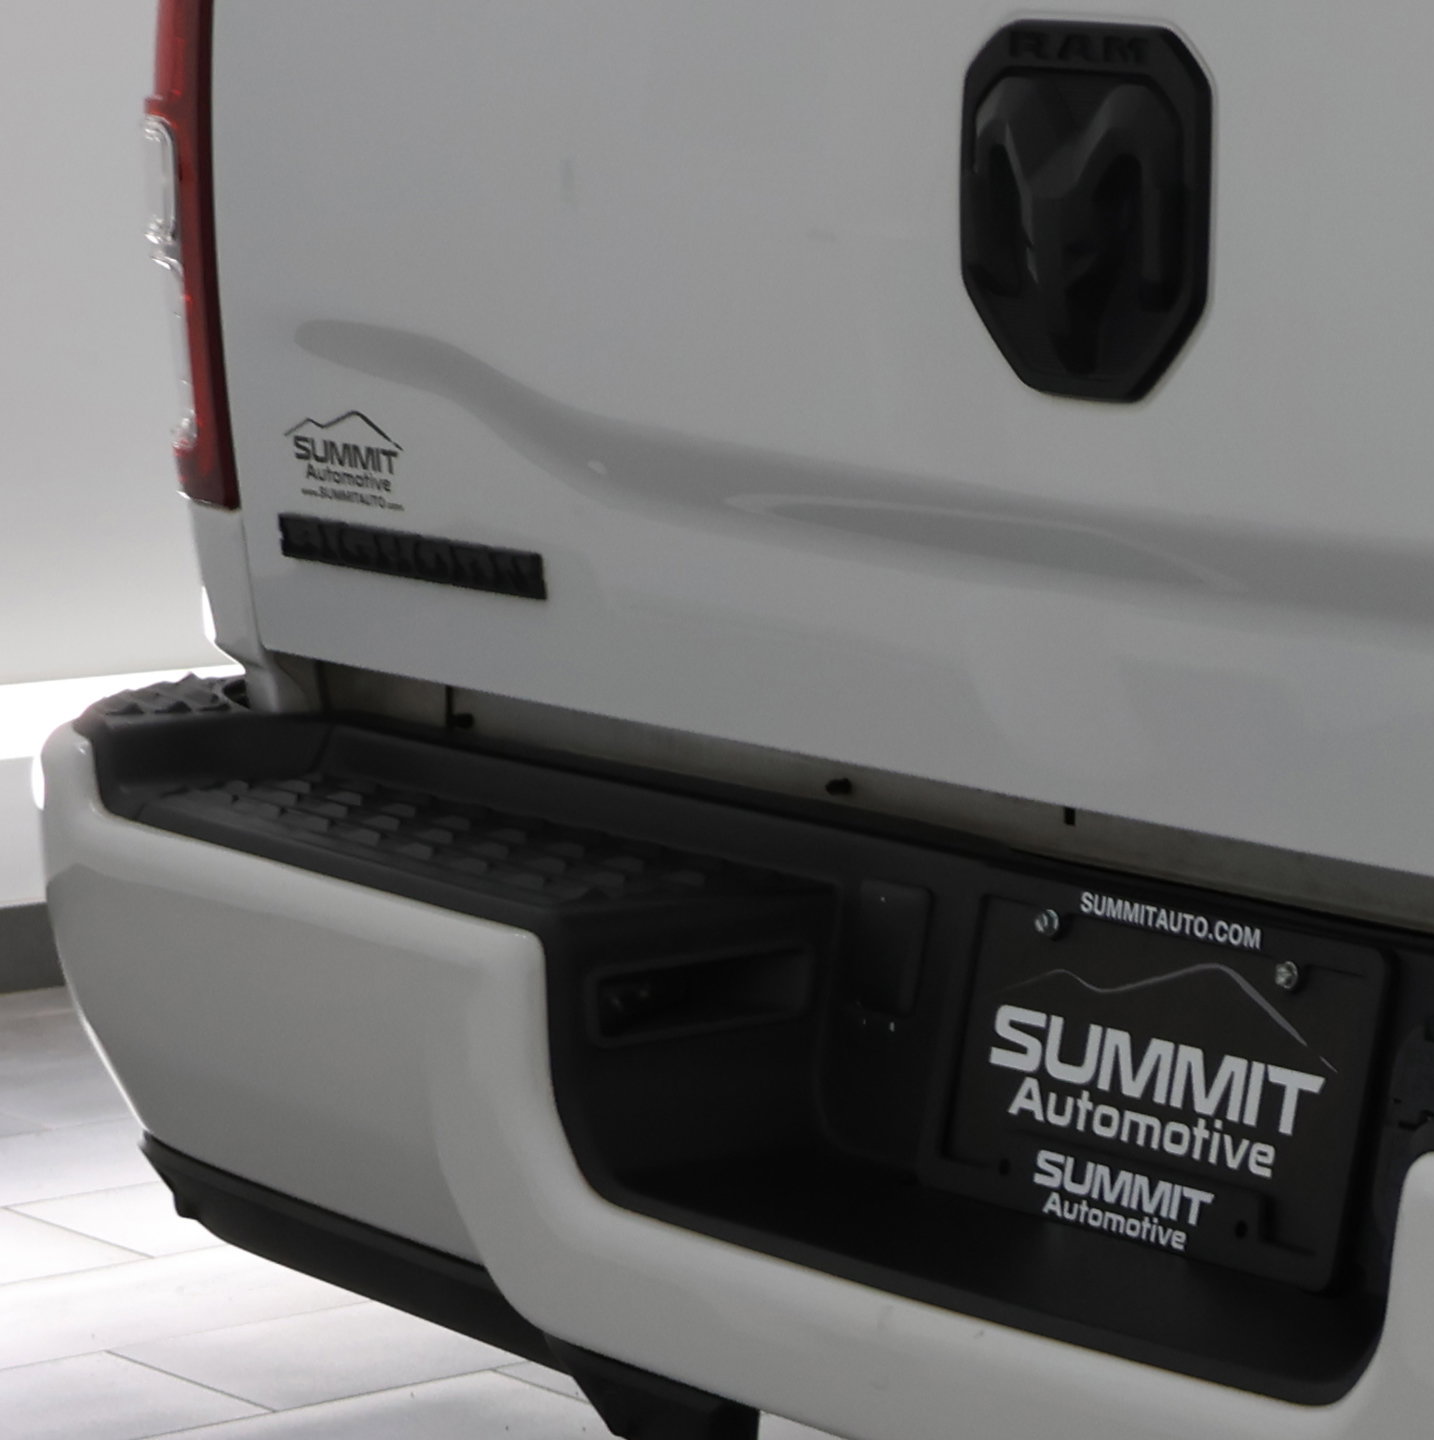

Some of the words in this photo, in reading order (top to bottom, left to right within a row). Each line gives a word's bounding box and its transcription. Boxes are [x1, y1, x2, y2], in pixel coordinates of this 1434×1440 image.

[293, 435, 398, 474] SUMMIT
[306, 462, 392, 493] Automotive
[1080, 890, 1262, 951] SUMMITAUTO.COM
[989, 1004, 1325, 1136] SUMMIT
[1008, 1076, 1277, 1179] Automotive
[1033, 1149, 1214, 1227] SUMMIT
[1042, 1191, 1188, 1253] Automotive
